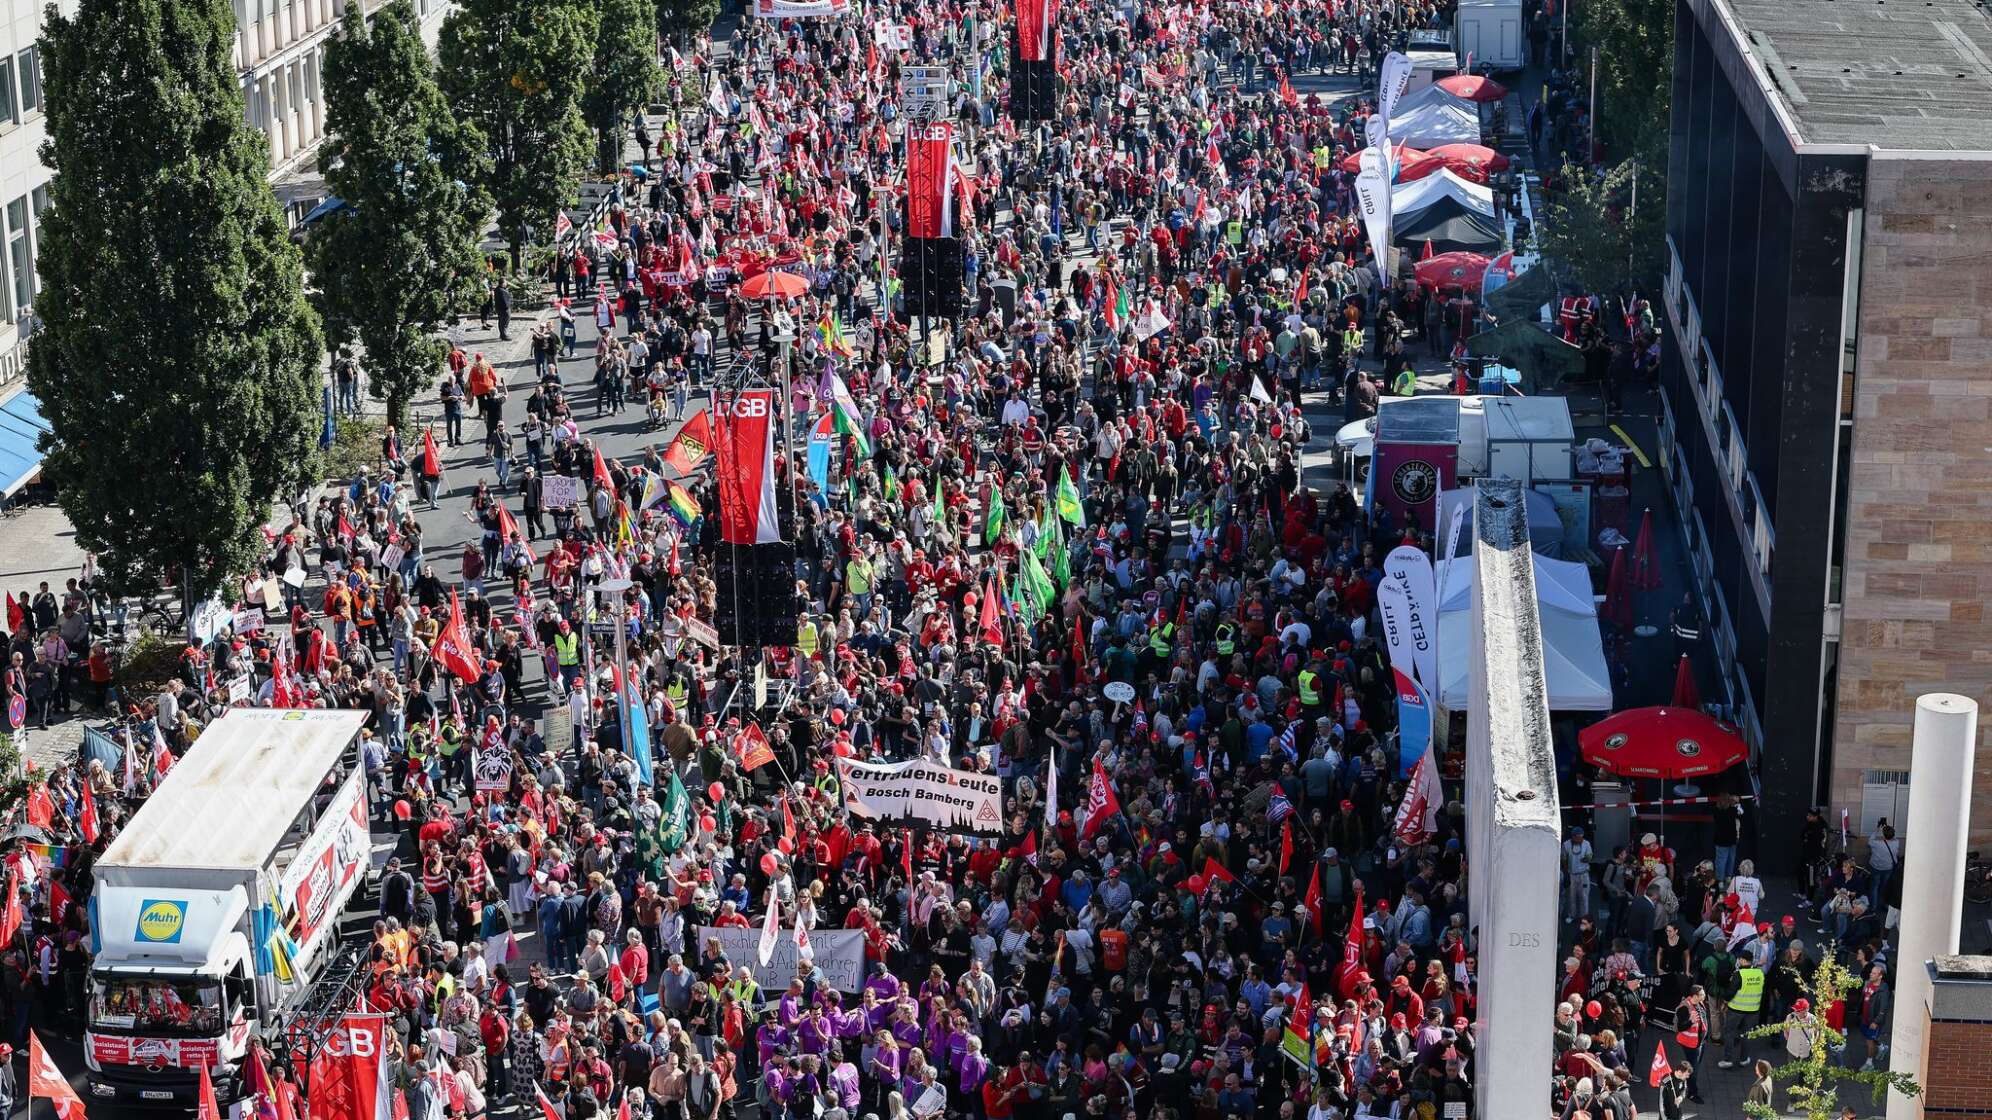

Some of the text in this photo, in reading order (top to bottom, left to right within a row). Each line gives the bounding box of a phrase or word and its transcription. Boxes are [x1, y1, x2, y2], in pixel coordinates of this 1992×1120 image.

[552, 487, 569, 496] FOR
[865, 787, 975, 811] Bosch Bamberg
[143, 911, 179, 923] Muhr
[1509, 932, 1541, 948] DES
